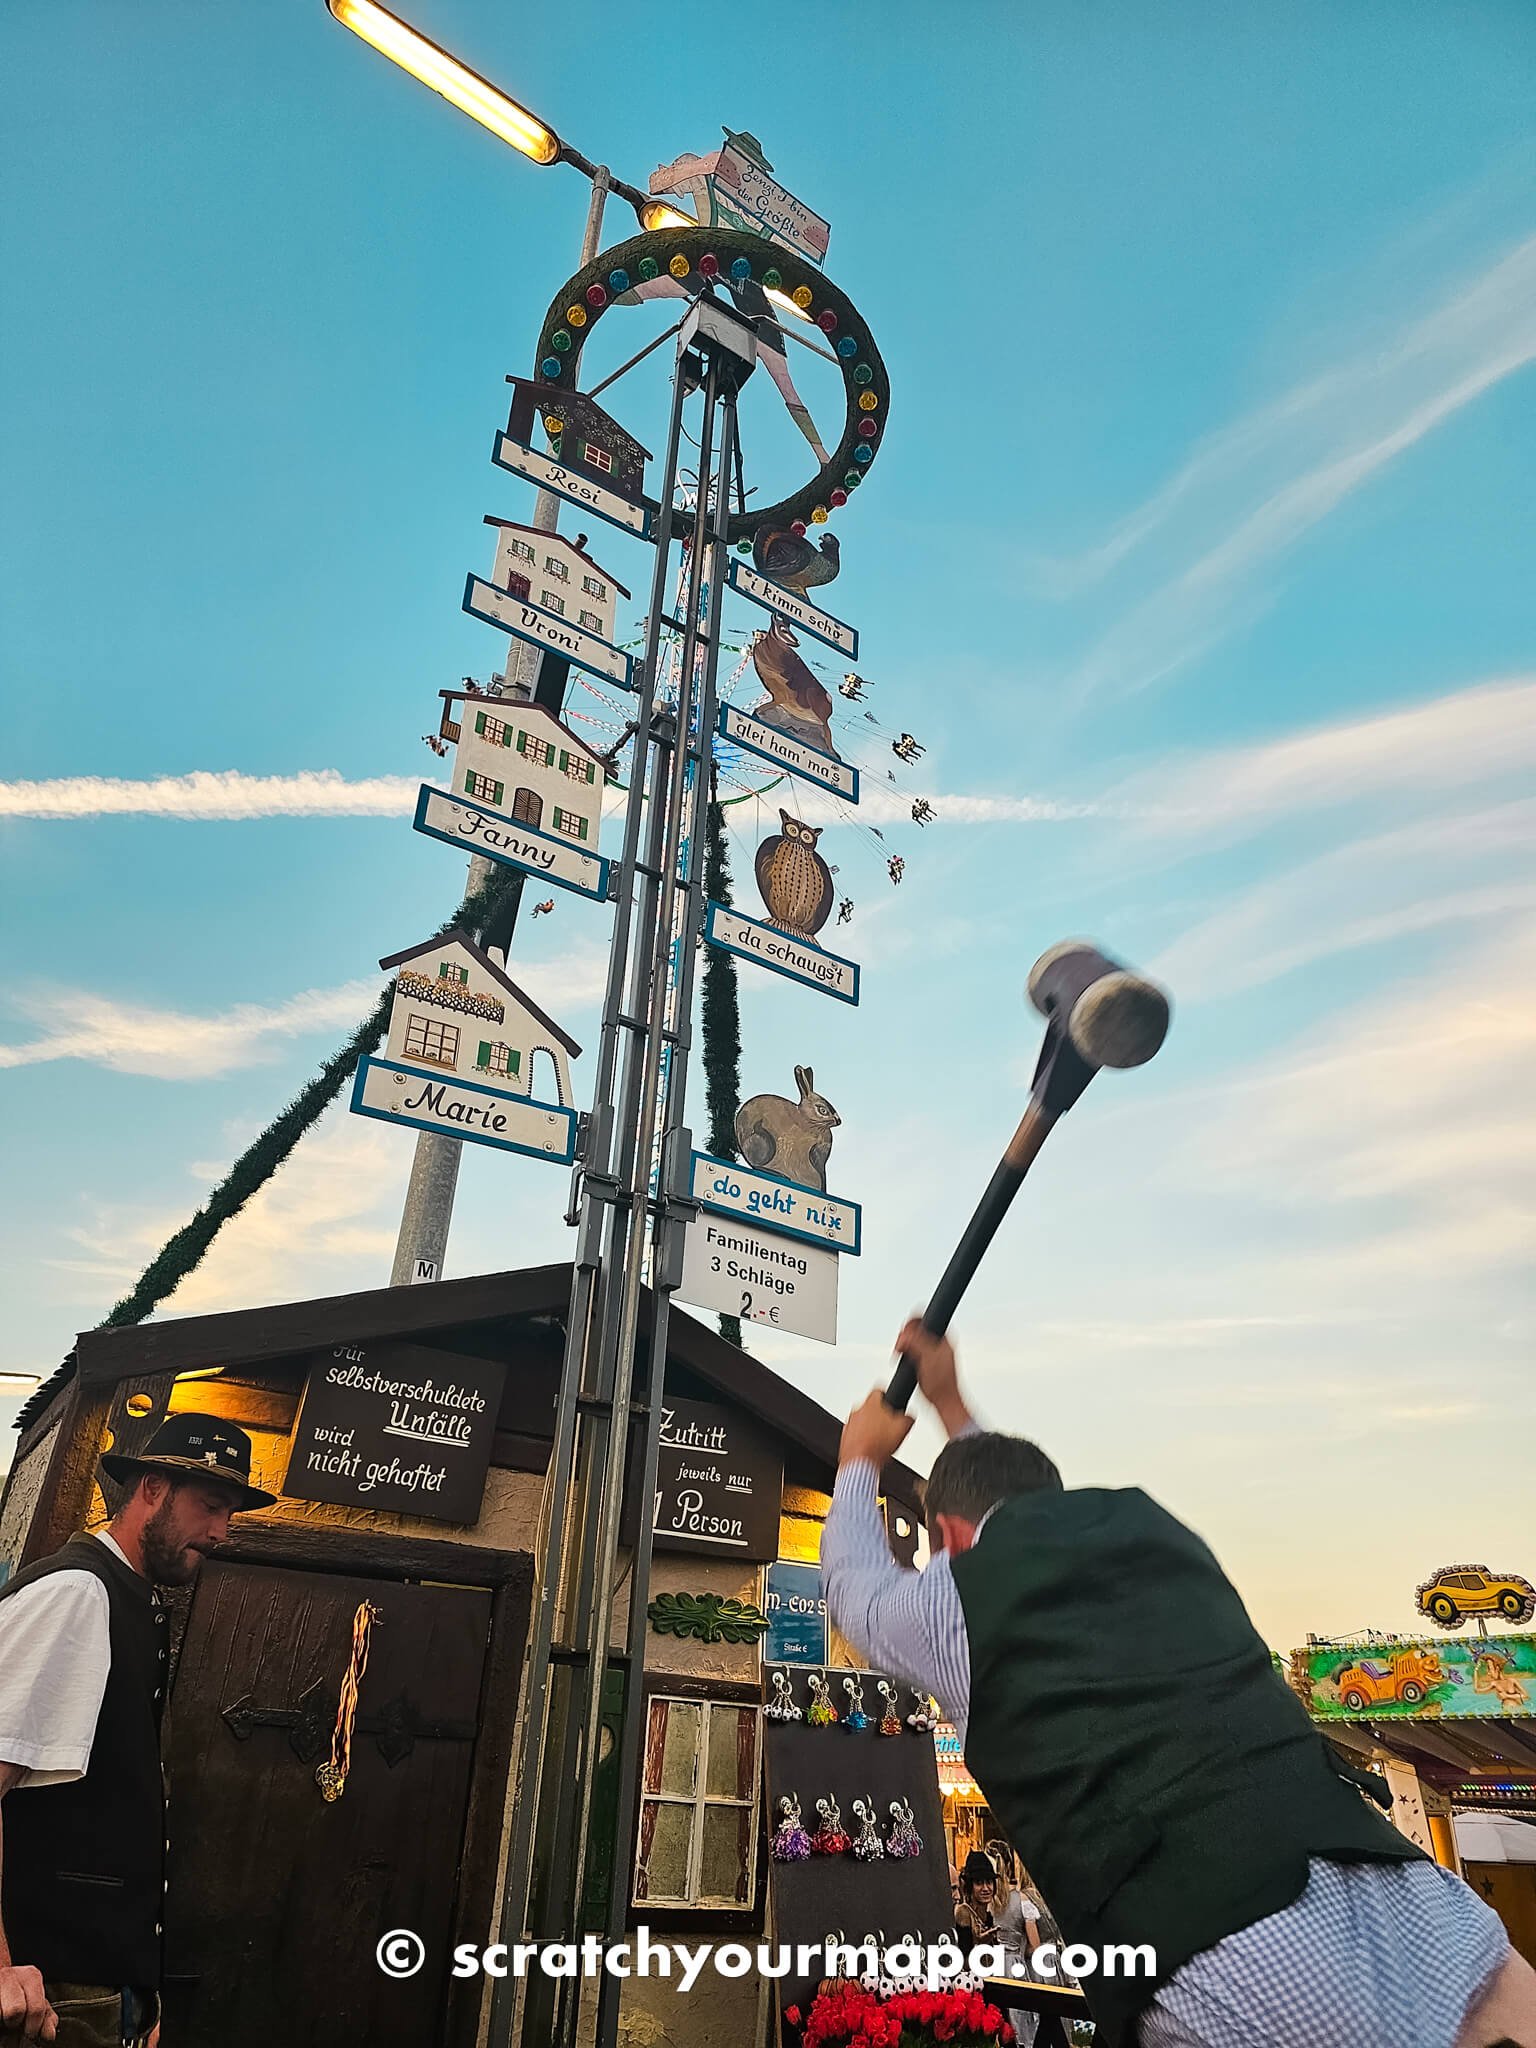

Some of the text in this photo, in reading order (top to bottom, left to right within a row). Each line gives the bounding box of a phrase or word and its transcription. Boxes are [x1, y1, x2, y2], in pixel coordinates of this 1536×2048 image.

[738, 188, 800, 240] der Größte
[789, 201, 807, 222] bin
[545, 467, 601, 505] Resi
[750, 578, 758, 591] i
[762, 583, 802, 618] kimm
[736, 723, 766, 745] glei
[458, 811, 556, 869] Fanny
[738, 927, 761, 950] da
[404, 1082, 508, 1132] Marie
[713, 1176, 741, 1198] do
[746, 1188, 796, 1215] geht
[417, 1262, 434, 1280] M
[706, 1227, 808, 1275] Familientag
[710, 1256, 796, 1295] 3 Schläge
[325, 1365, 486, 1413] selbstverschuldete
[314, 1426, 355, 1447] wird
[390, 1400, 472, 1440] Unfälle
[659, 1407, 727, 1448] Zutritt
[306, 1449, 447, 1492] nicht gehaftet
[675, 1462, 752, 1488] jeweils nur
[672, 1490, 743, 1536] Person
